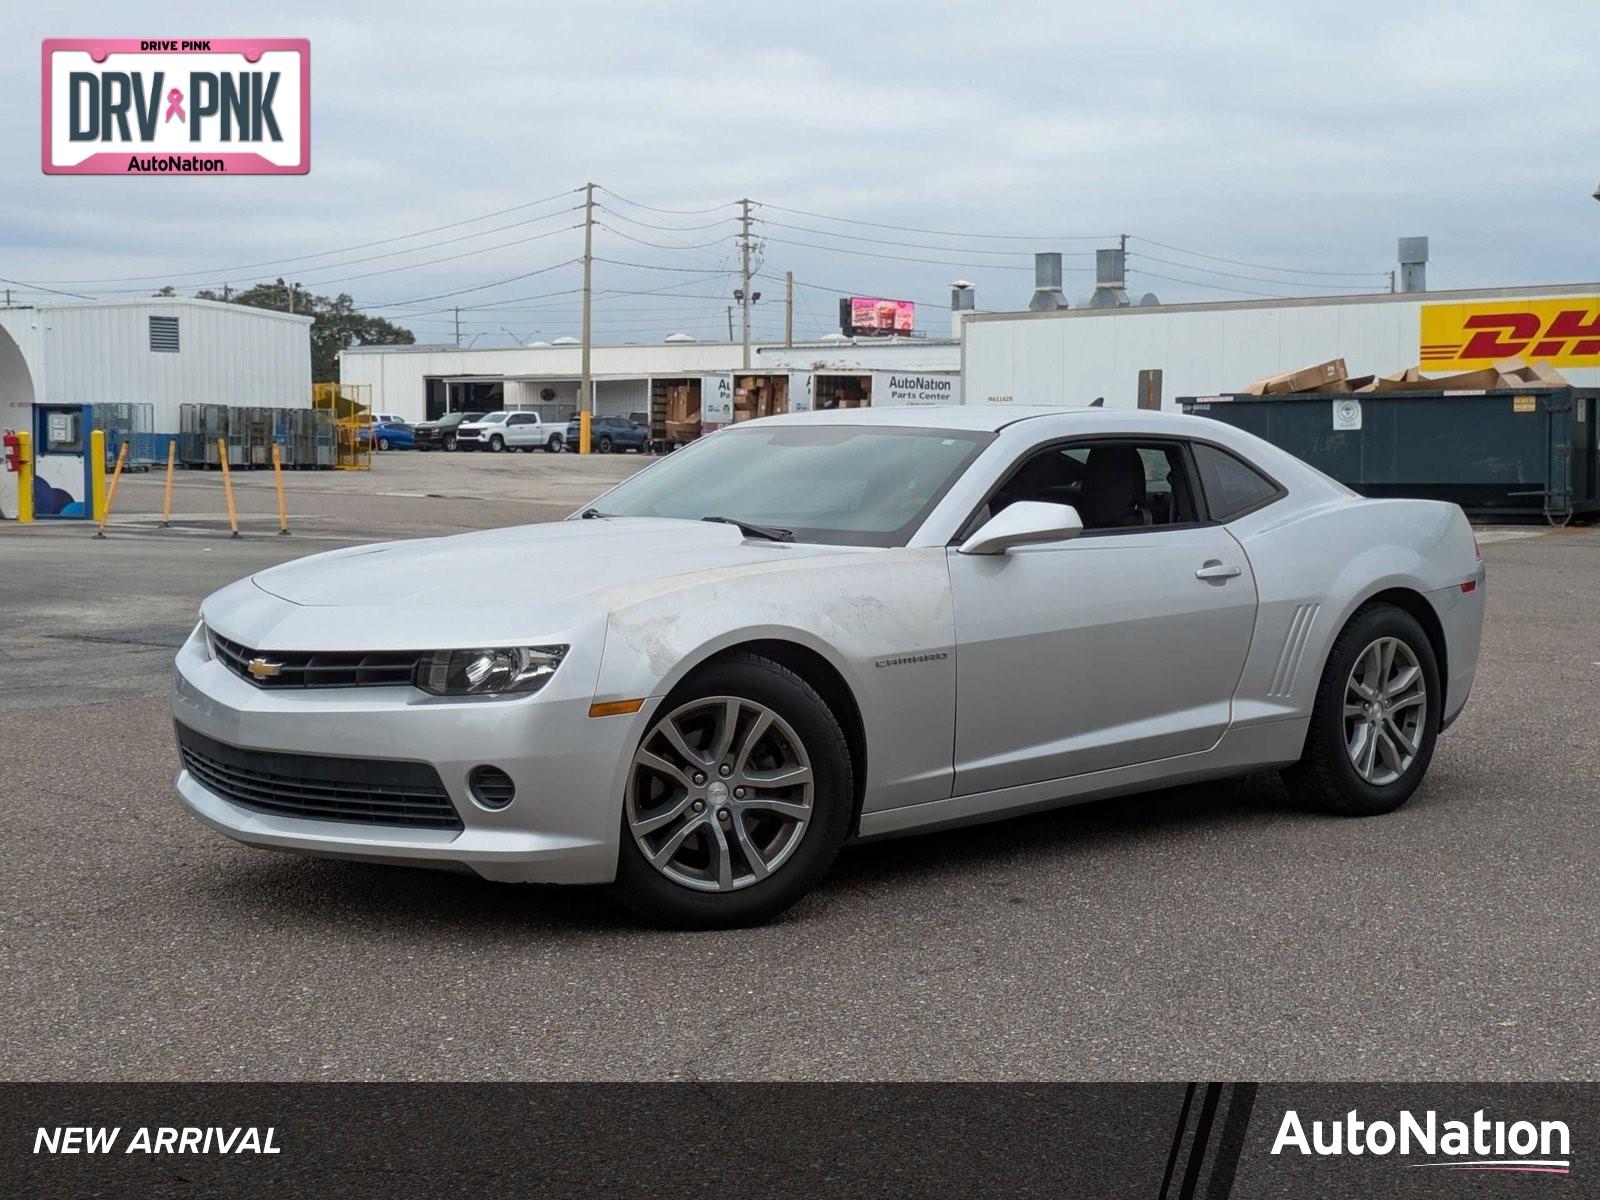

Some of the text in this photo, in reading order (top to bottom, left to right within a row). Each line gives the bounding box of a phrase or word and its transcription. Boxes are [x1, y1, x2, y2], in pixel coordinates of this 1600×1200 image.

[889, 376, 951, 391] AutoNation
[891, 391, 951, 400] Parts Center
[875, 653, 948, 668] CAMARO
